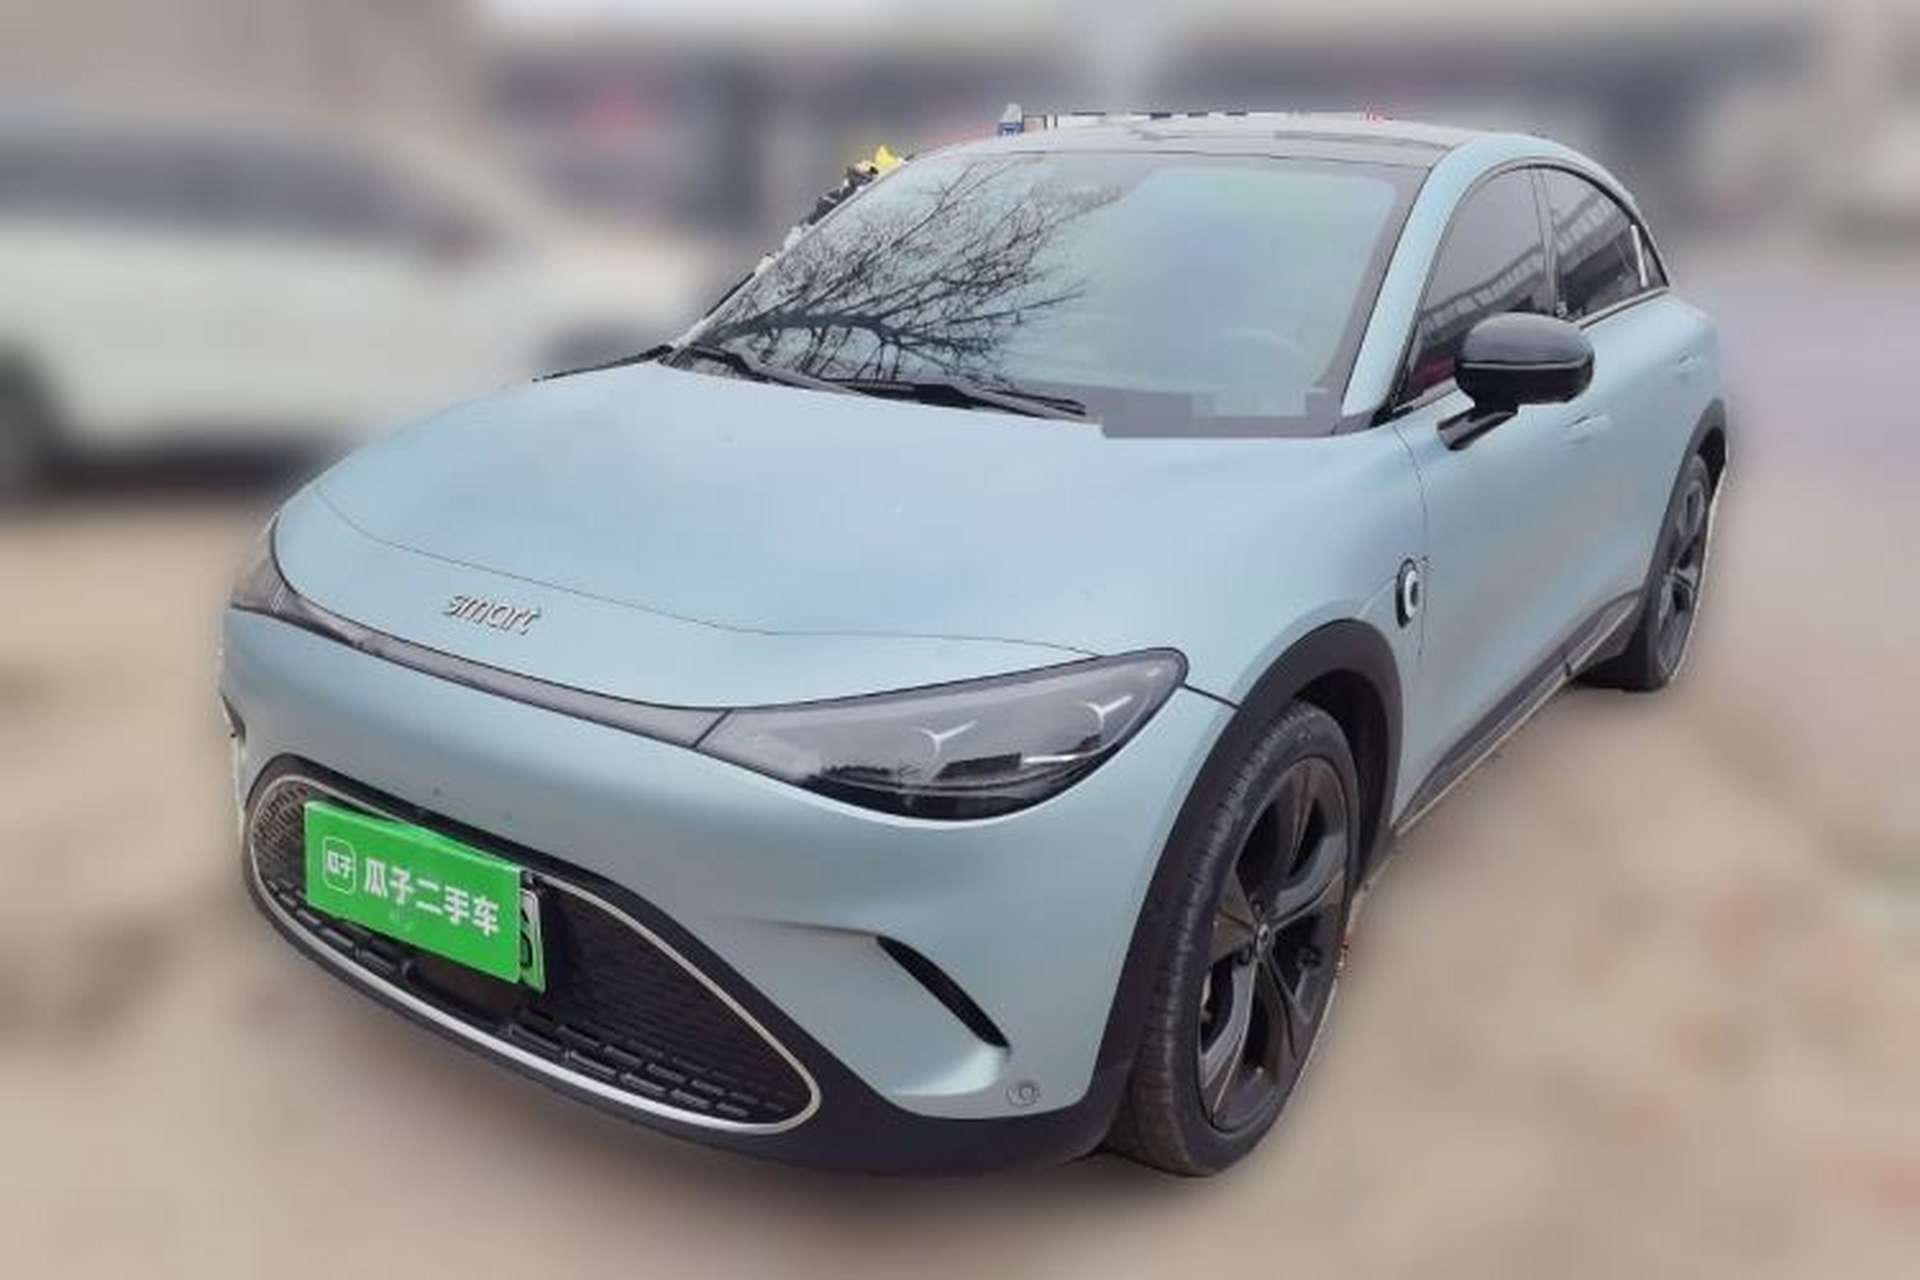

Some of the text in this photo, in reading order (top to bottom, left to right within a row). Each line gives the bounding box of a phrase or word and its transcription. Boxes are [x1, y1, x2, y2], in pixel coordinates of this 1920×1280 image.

[444, 594, 541, 636] smart
[363, 856, 500, 937] 瓜子二手车
